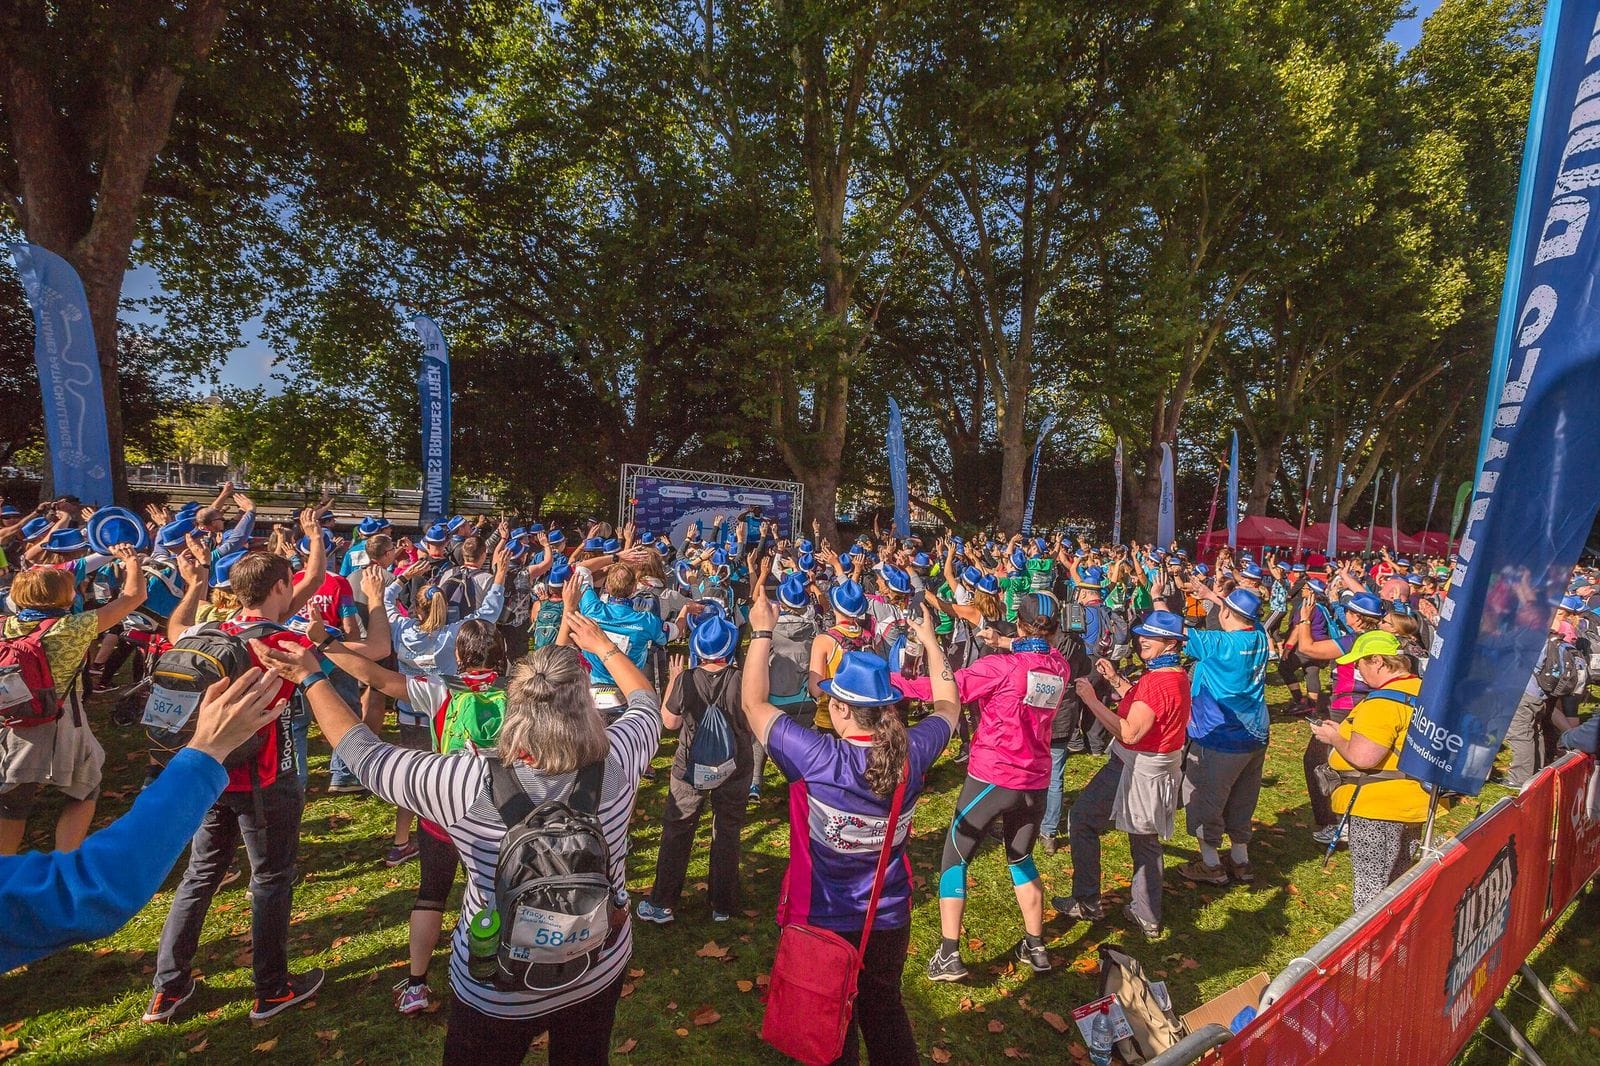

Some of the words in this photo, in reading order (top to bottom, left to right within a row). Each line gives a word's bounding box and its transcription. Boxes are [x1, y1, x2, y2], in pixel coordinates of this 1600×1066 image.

[1035, 682, 1056, 696] 5338
[153, 699, 183, 716] 5874
[1410, 705, 1464, 754] allenge
[1412, 742, 1454, 774] worldwide
[1456, 855, 1513, 958] ULTRA
[534, 928, 591, 947] 5845
[1451, 979, 1474, 1033] WALK
